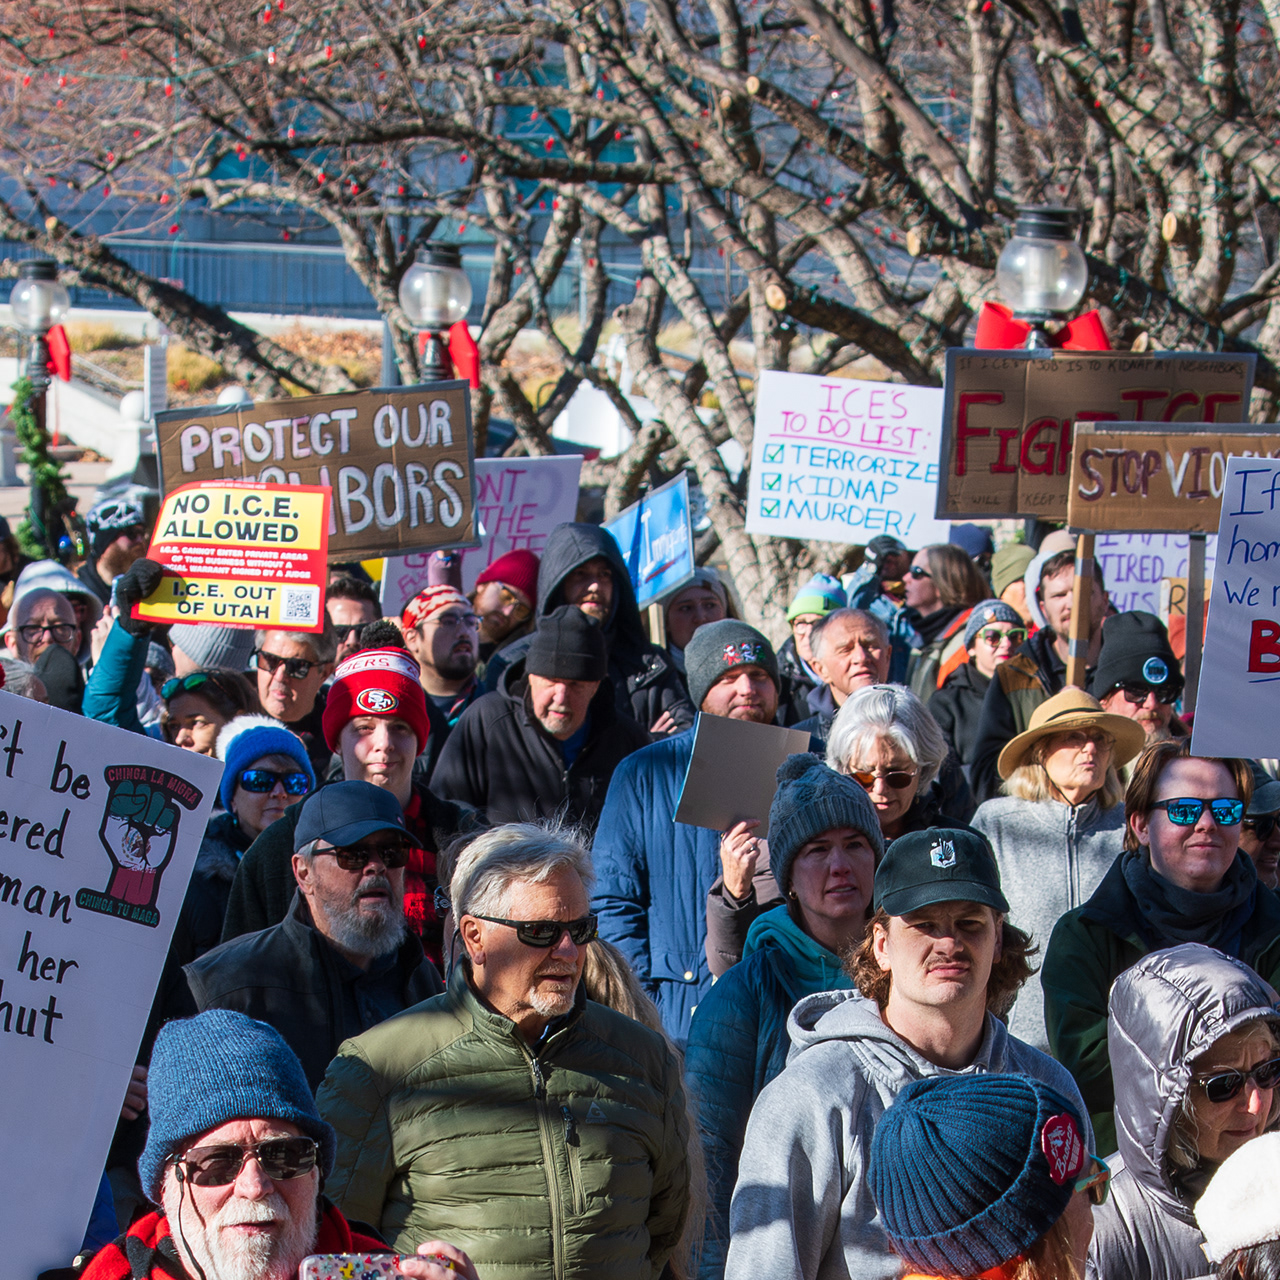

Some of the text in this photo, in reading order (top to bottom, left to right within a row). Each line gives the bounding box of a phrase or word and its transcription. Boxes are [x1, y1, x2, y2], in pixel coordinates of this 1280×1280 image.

[819, 384, 907, 419] ICE'S
[180, 399, 453, 473] PROTECT OUR
[781, 411, 806, 432] TO
[818, 415, 851, 438] DO
[791, 444, 939, 484] TERRORIZE
[1078, 447, 1162, 502] STOP
[787, 473, 898, 504] KIDNAP
[172, 493, 299, 519] NO I.C.E.
[784, 498, 917, 537] MURDER!
[162, 519, 299, 542] ALLOWED
[1099, 552, 1165, 584] TIRED
[172, 581, 277, 600] I.C.E. OUT
[1223, 576, 1260, 608] We
[177, 601, 270, 619] OF UTAH
[50, 740, 91, 800] be
[108, 767, 200, 805] CHINGA LA MIGRA
[78, 893, 158, 926] CHINGA TU MAGA
[17, 930, 79, 985] her
